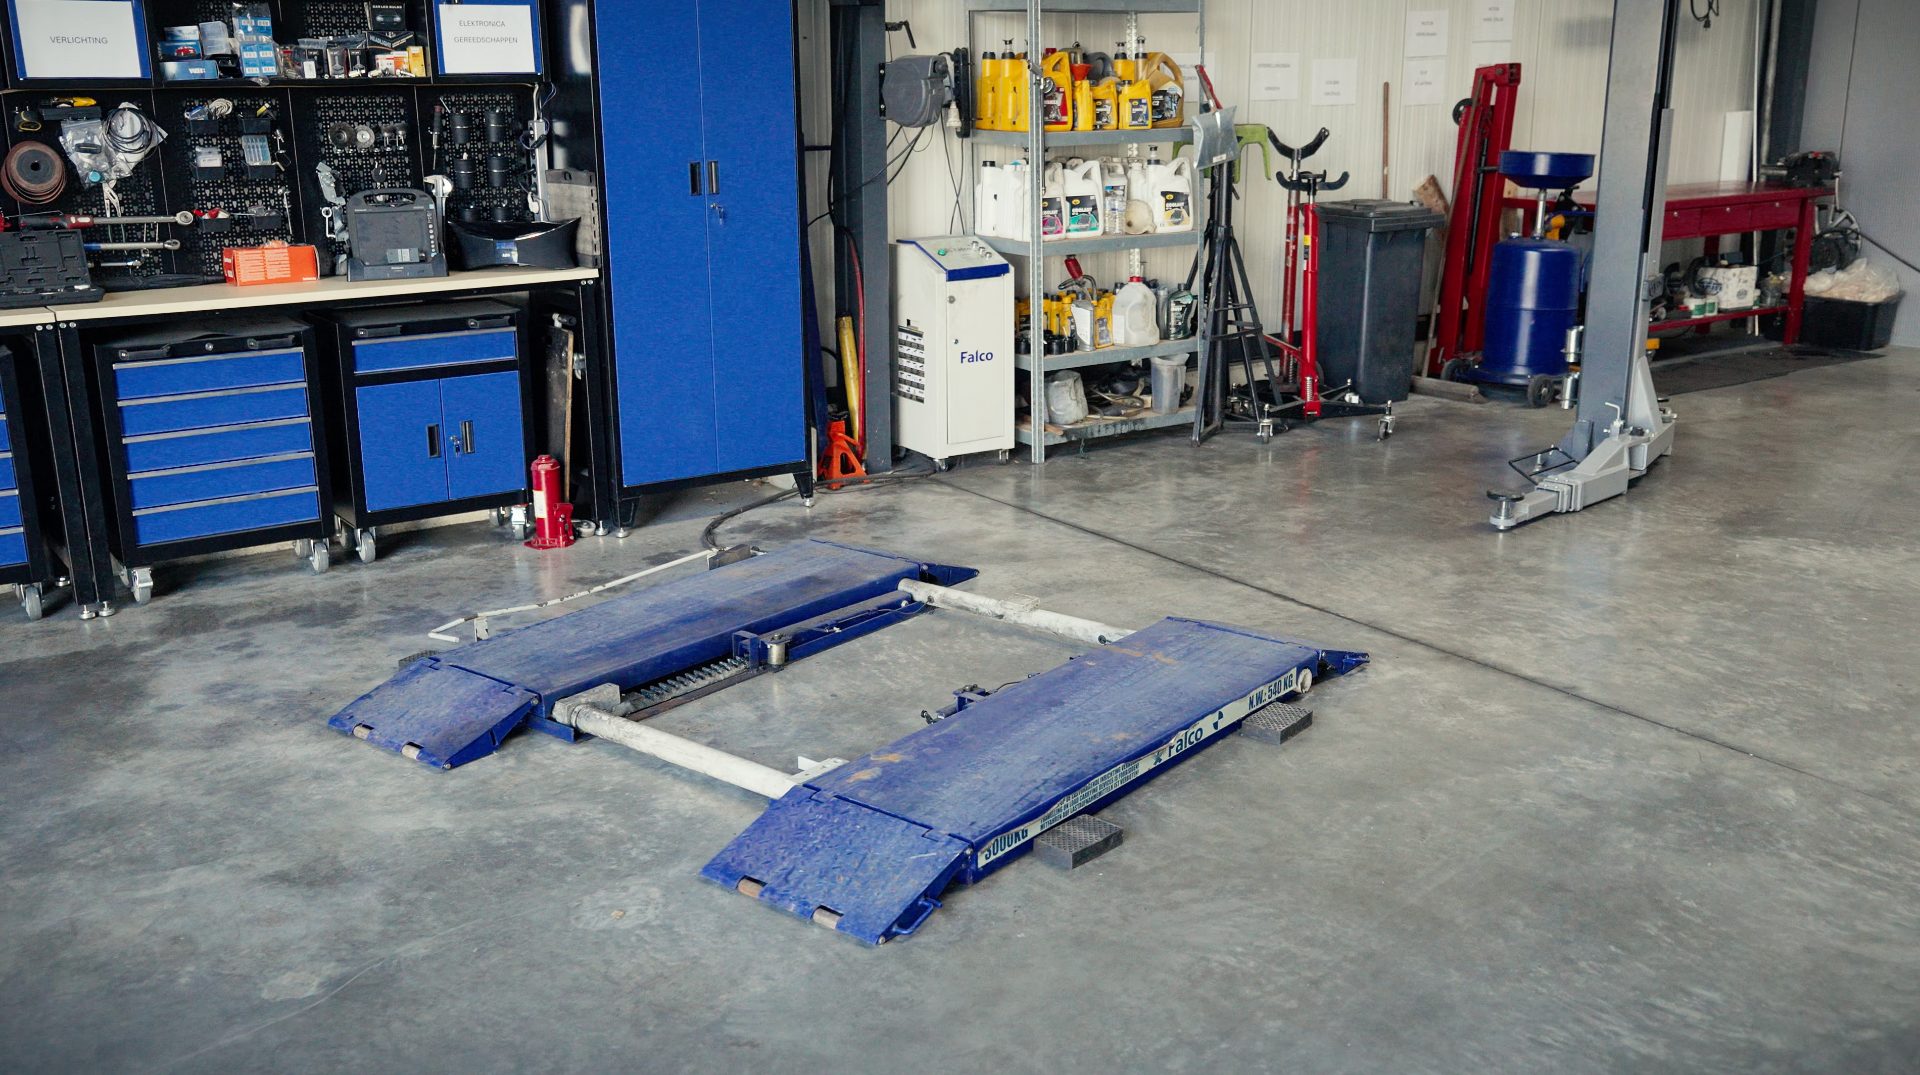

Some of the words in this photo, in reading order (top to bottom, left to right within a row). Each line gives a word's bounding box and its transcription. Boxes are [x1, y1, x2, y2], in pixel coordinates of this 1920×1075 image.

[458, 20, 506, 28] ELEKTRONICA
[50, 36, 108, 45] VERLICHTING
[454, 36, 518, 44] GEREEDSCHAPPEN
[960, 350, 994, 364] Falco
[1248, 689, 1267, 711] N.W.:
[1267, 679, 1282, 700] 540
[1283, 673, 1294, 691] KG
